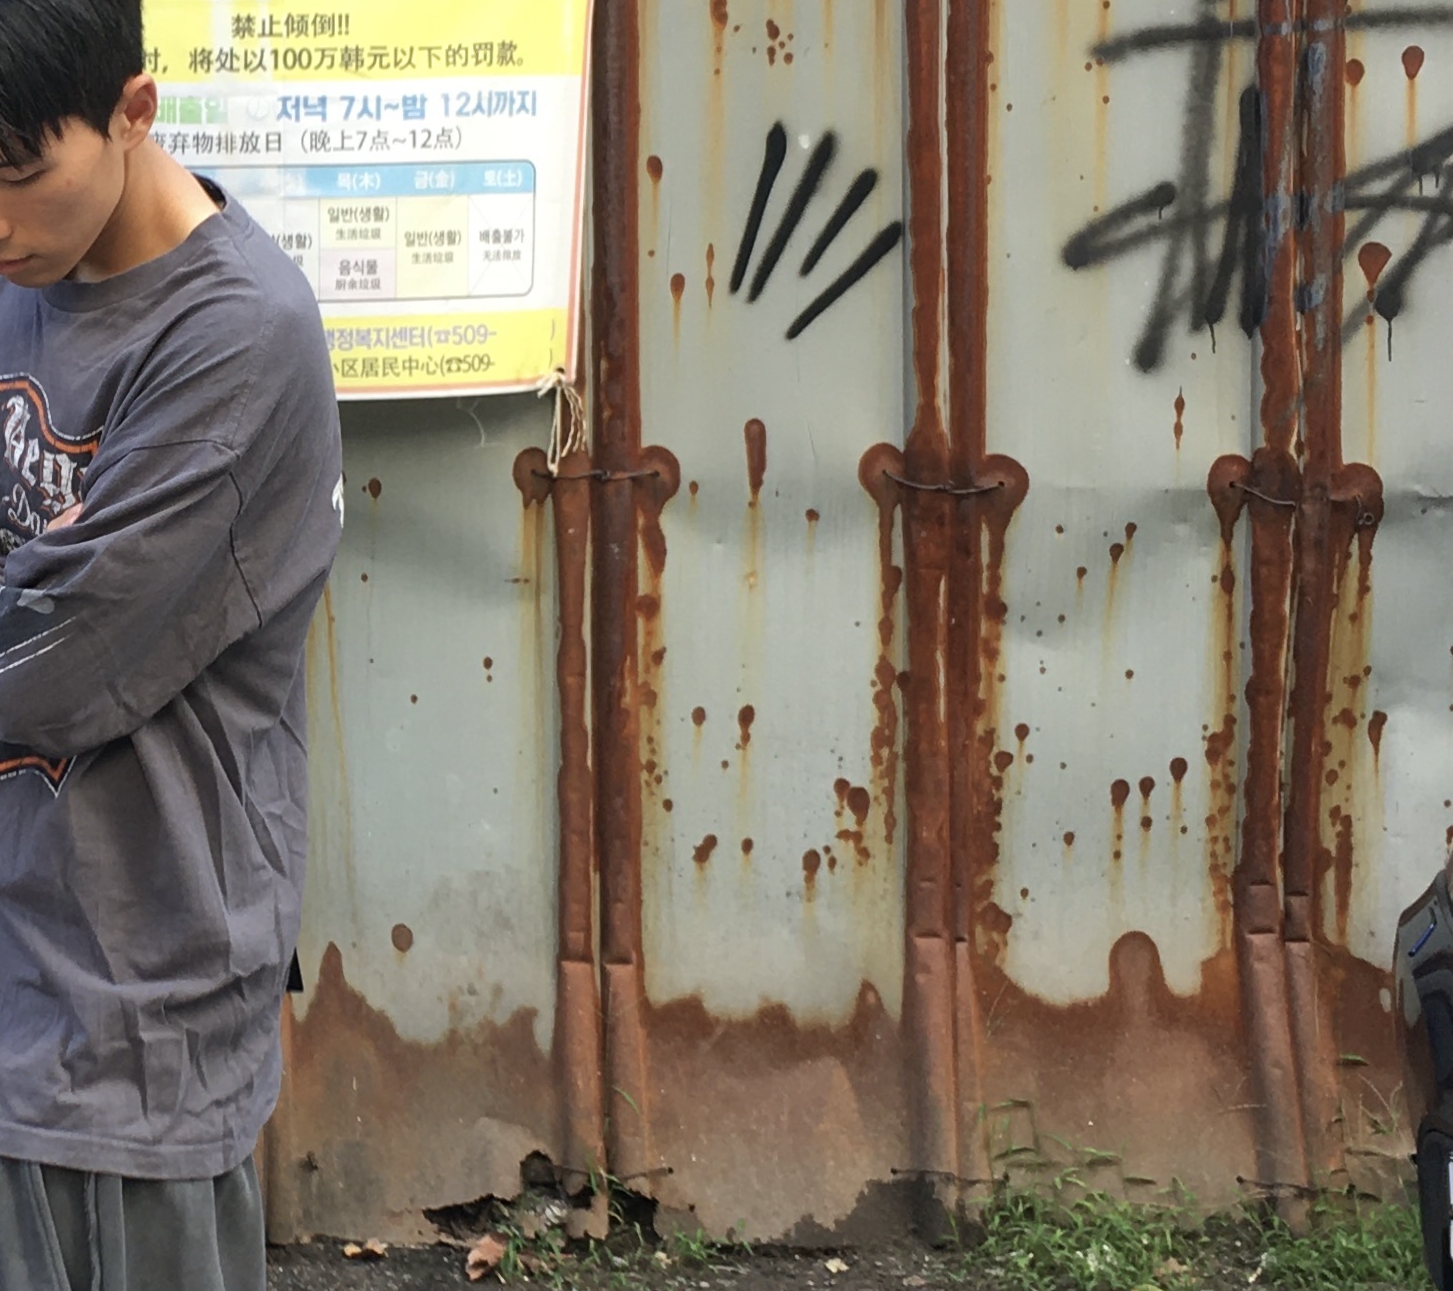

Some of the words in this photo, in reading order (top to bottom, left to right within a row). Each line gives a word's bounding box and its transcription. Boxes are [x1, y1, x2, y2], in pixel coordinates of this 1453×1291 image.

[231, 12, 350, 39] 禁止倾倒!!
[276, 94, 328, 124] 저녁
[339, 92, 428, 122] 7시~밤
[441, 89, 538, 119] 12시까지
[328, 206, 389, 224] 일반(생활)
[271, 233, 313, 253] (생활)
[404, 229, 462, 248] 일반(생활)
